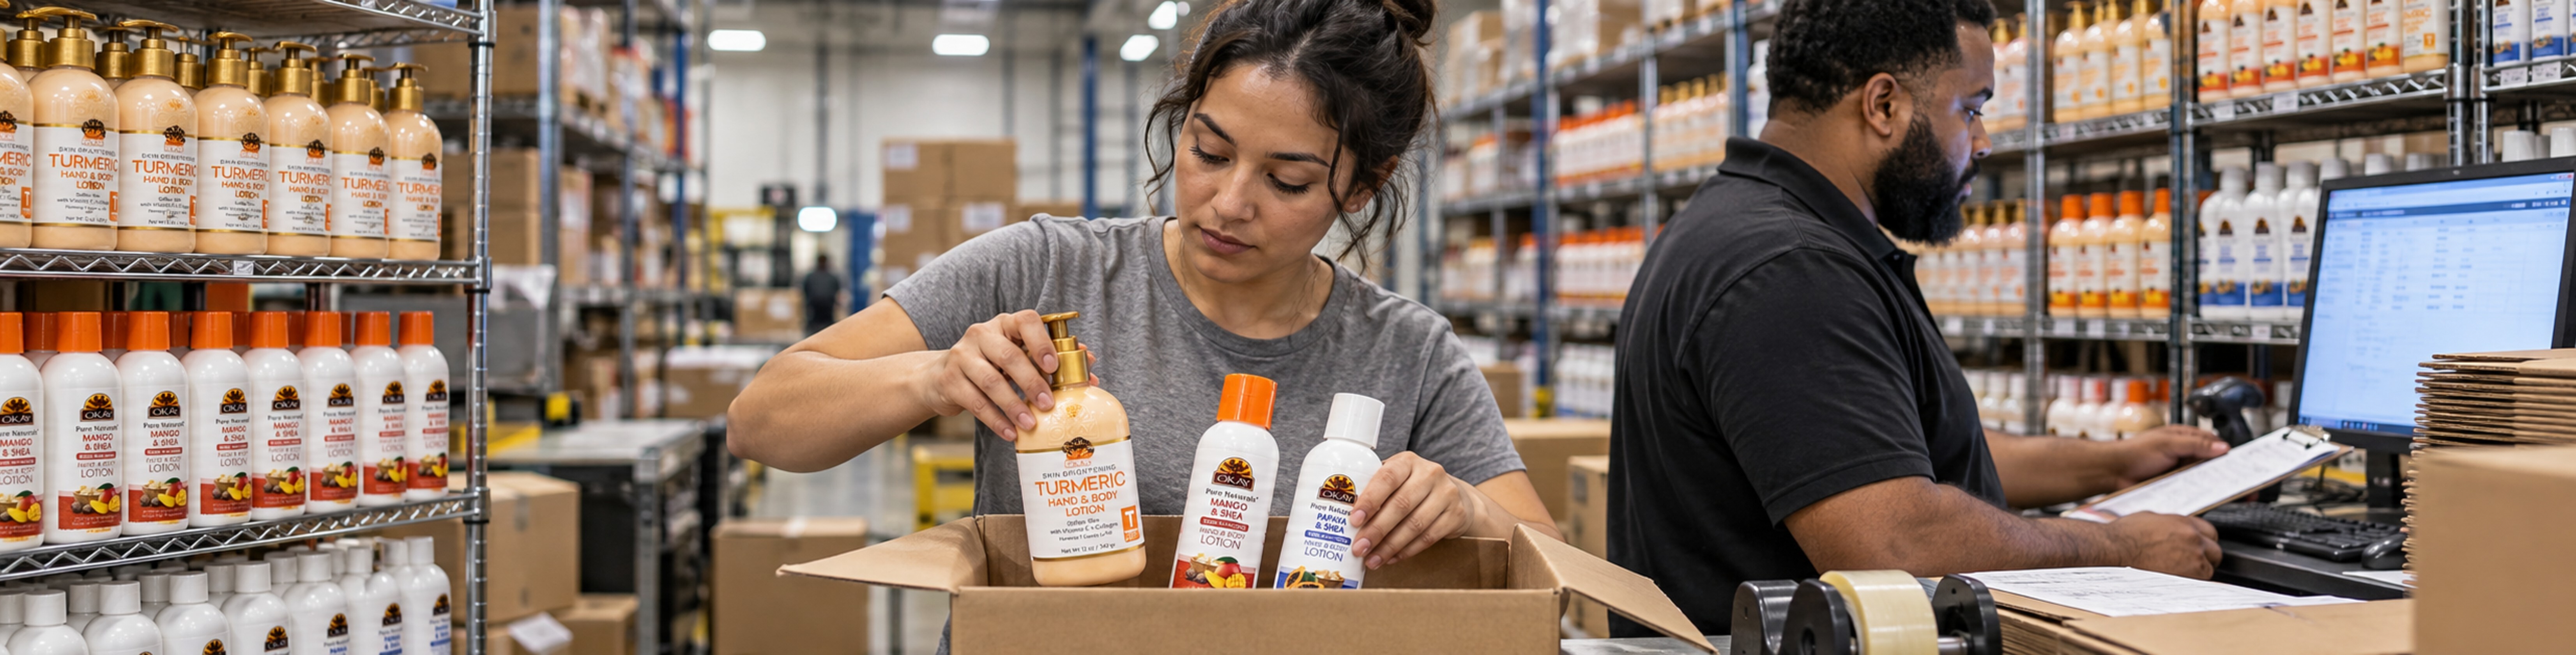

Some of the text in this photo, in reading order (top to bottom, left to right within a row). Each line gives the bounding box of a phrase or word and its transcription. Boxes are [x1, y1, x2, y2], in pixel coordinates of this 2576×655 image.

[49, 154, 118, 172] TURMERIC
[61, 170, 88, 179] HAND
[0, 438, 32, 447] MANGO
[83, 433, 113, 442] MANGO
[11, 448, 30, 456] SHEA
[81, 468, 113, 478] LOTION
[1035, 471, 1126, 496] TURMERIC
[1217, 474, 1250, 487] OKAY
[1048, 490, 1117, 507] HAND & BODY
[1210, 498, 1248, 511] MANGO
[1066, 504, 1105, 517] LOTION
[1210, 508, 1243, 520] & SHEA
[1125, 510, 1134, 527] T
[1200, 535, 1241, 550] LOTION
[1305, 546, 1343, 561] LOTION
